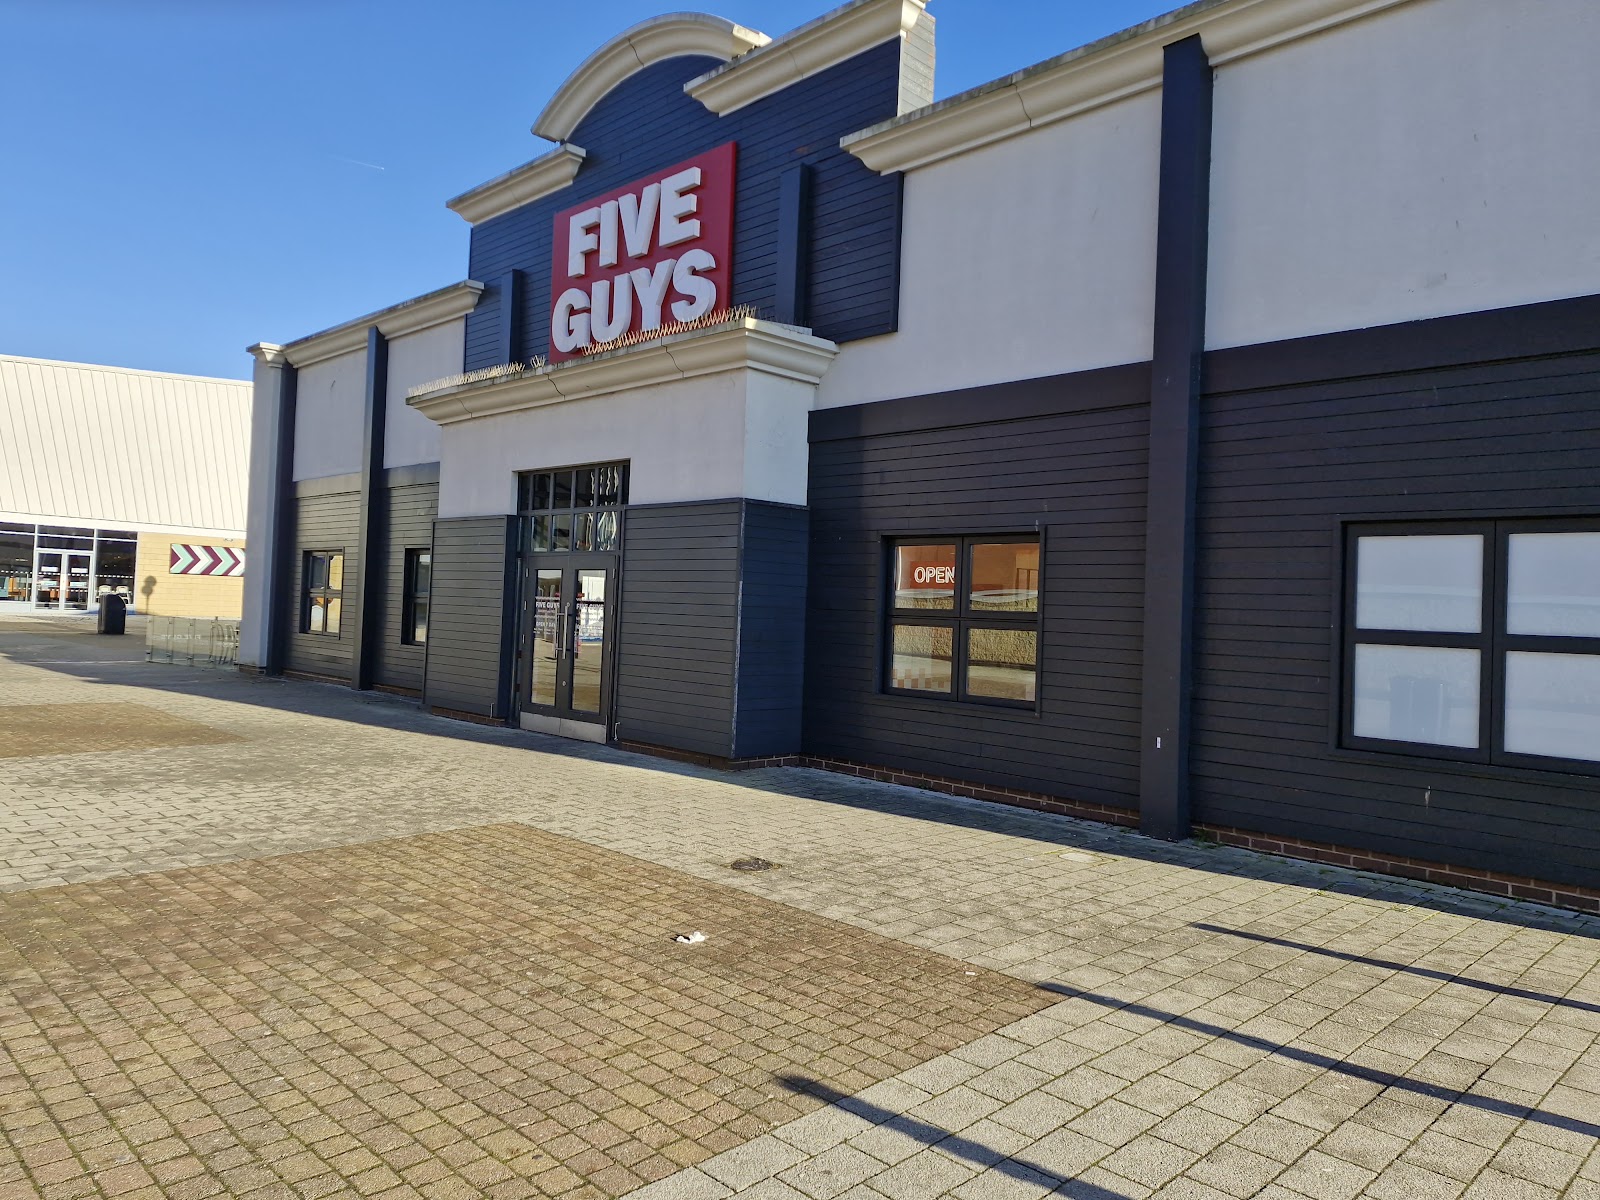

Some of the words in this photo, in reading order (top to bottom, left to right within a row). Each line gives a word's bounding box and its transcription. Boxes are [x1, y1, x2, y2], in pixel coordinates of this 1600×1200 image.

[567, 166, 701, 277] FIVE
[551, 249, 717, 353] GUYS
[914, 566, 956, 584] OPEN
